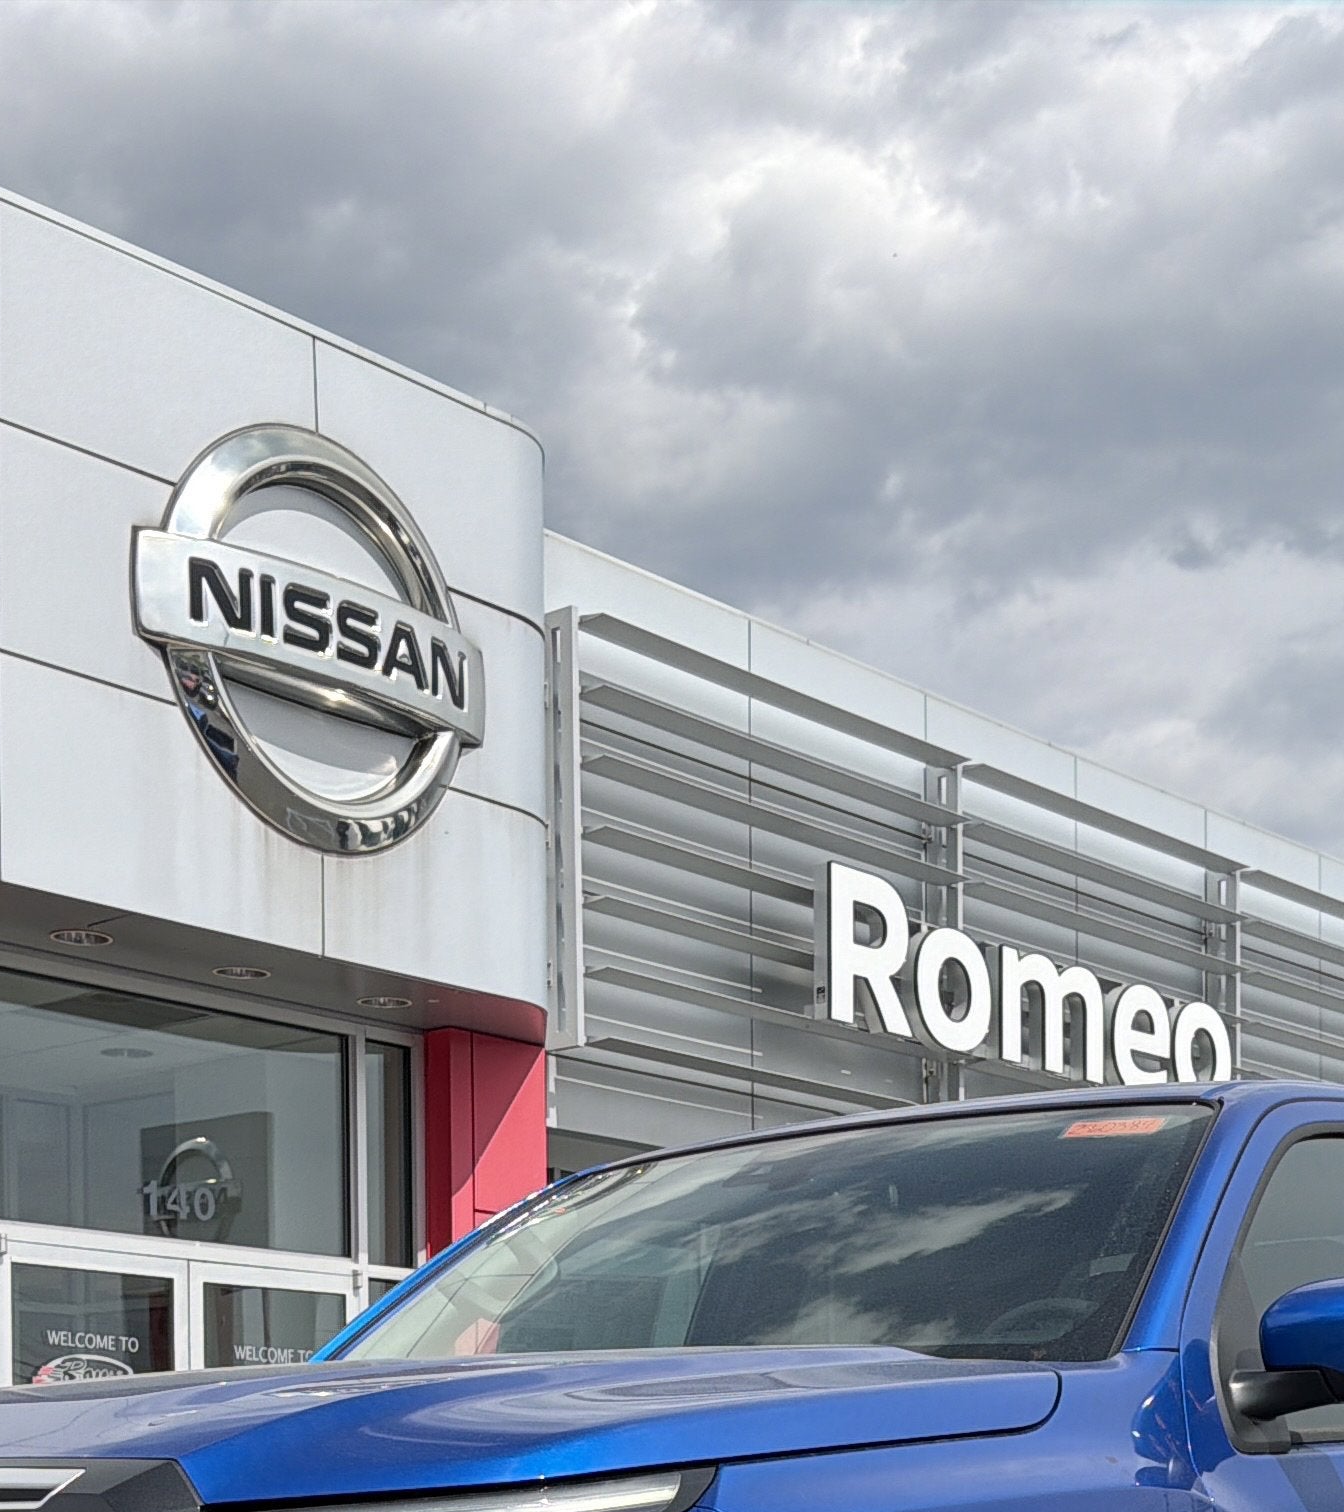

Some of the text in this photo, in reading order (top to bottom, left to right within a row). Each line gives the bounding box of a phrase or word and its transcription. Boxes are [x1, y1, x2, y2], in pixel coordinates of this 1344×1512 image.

[189, 557, 468, 712] NISSAN
[829, 860, 1232, 1085] Romeo
[143, 1180, 215, 1221] 140
[47, 1329, 139, 1353] WELCOME TO
[234, 1345, 295, 1364] WELCOME
